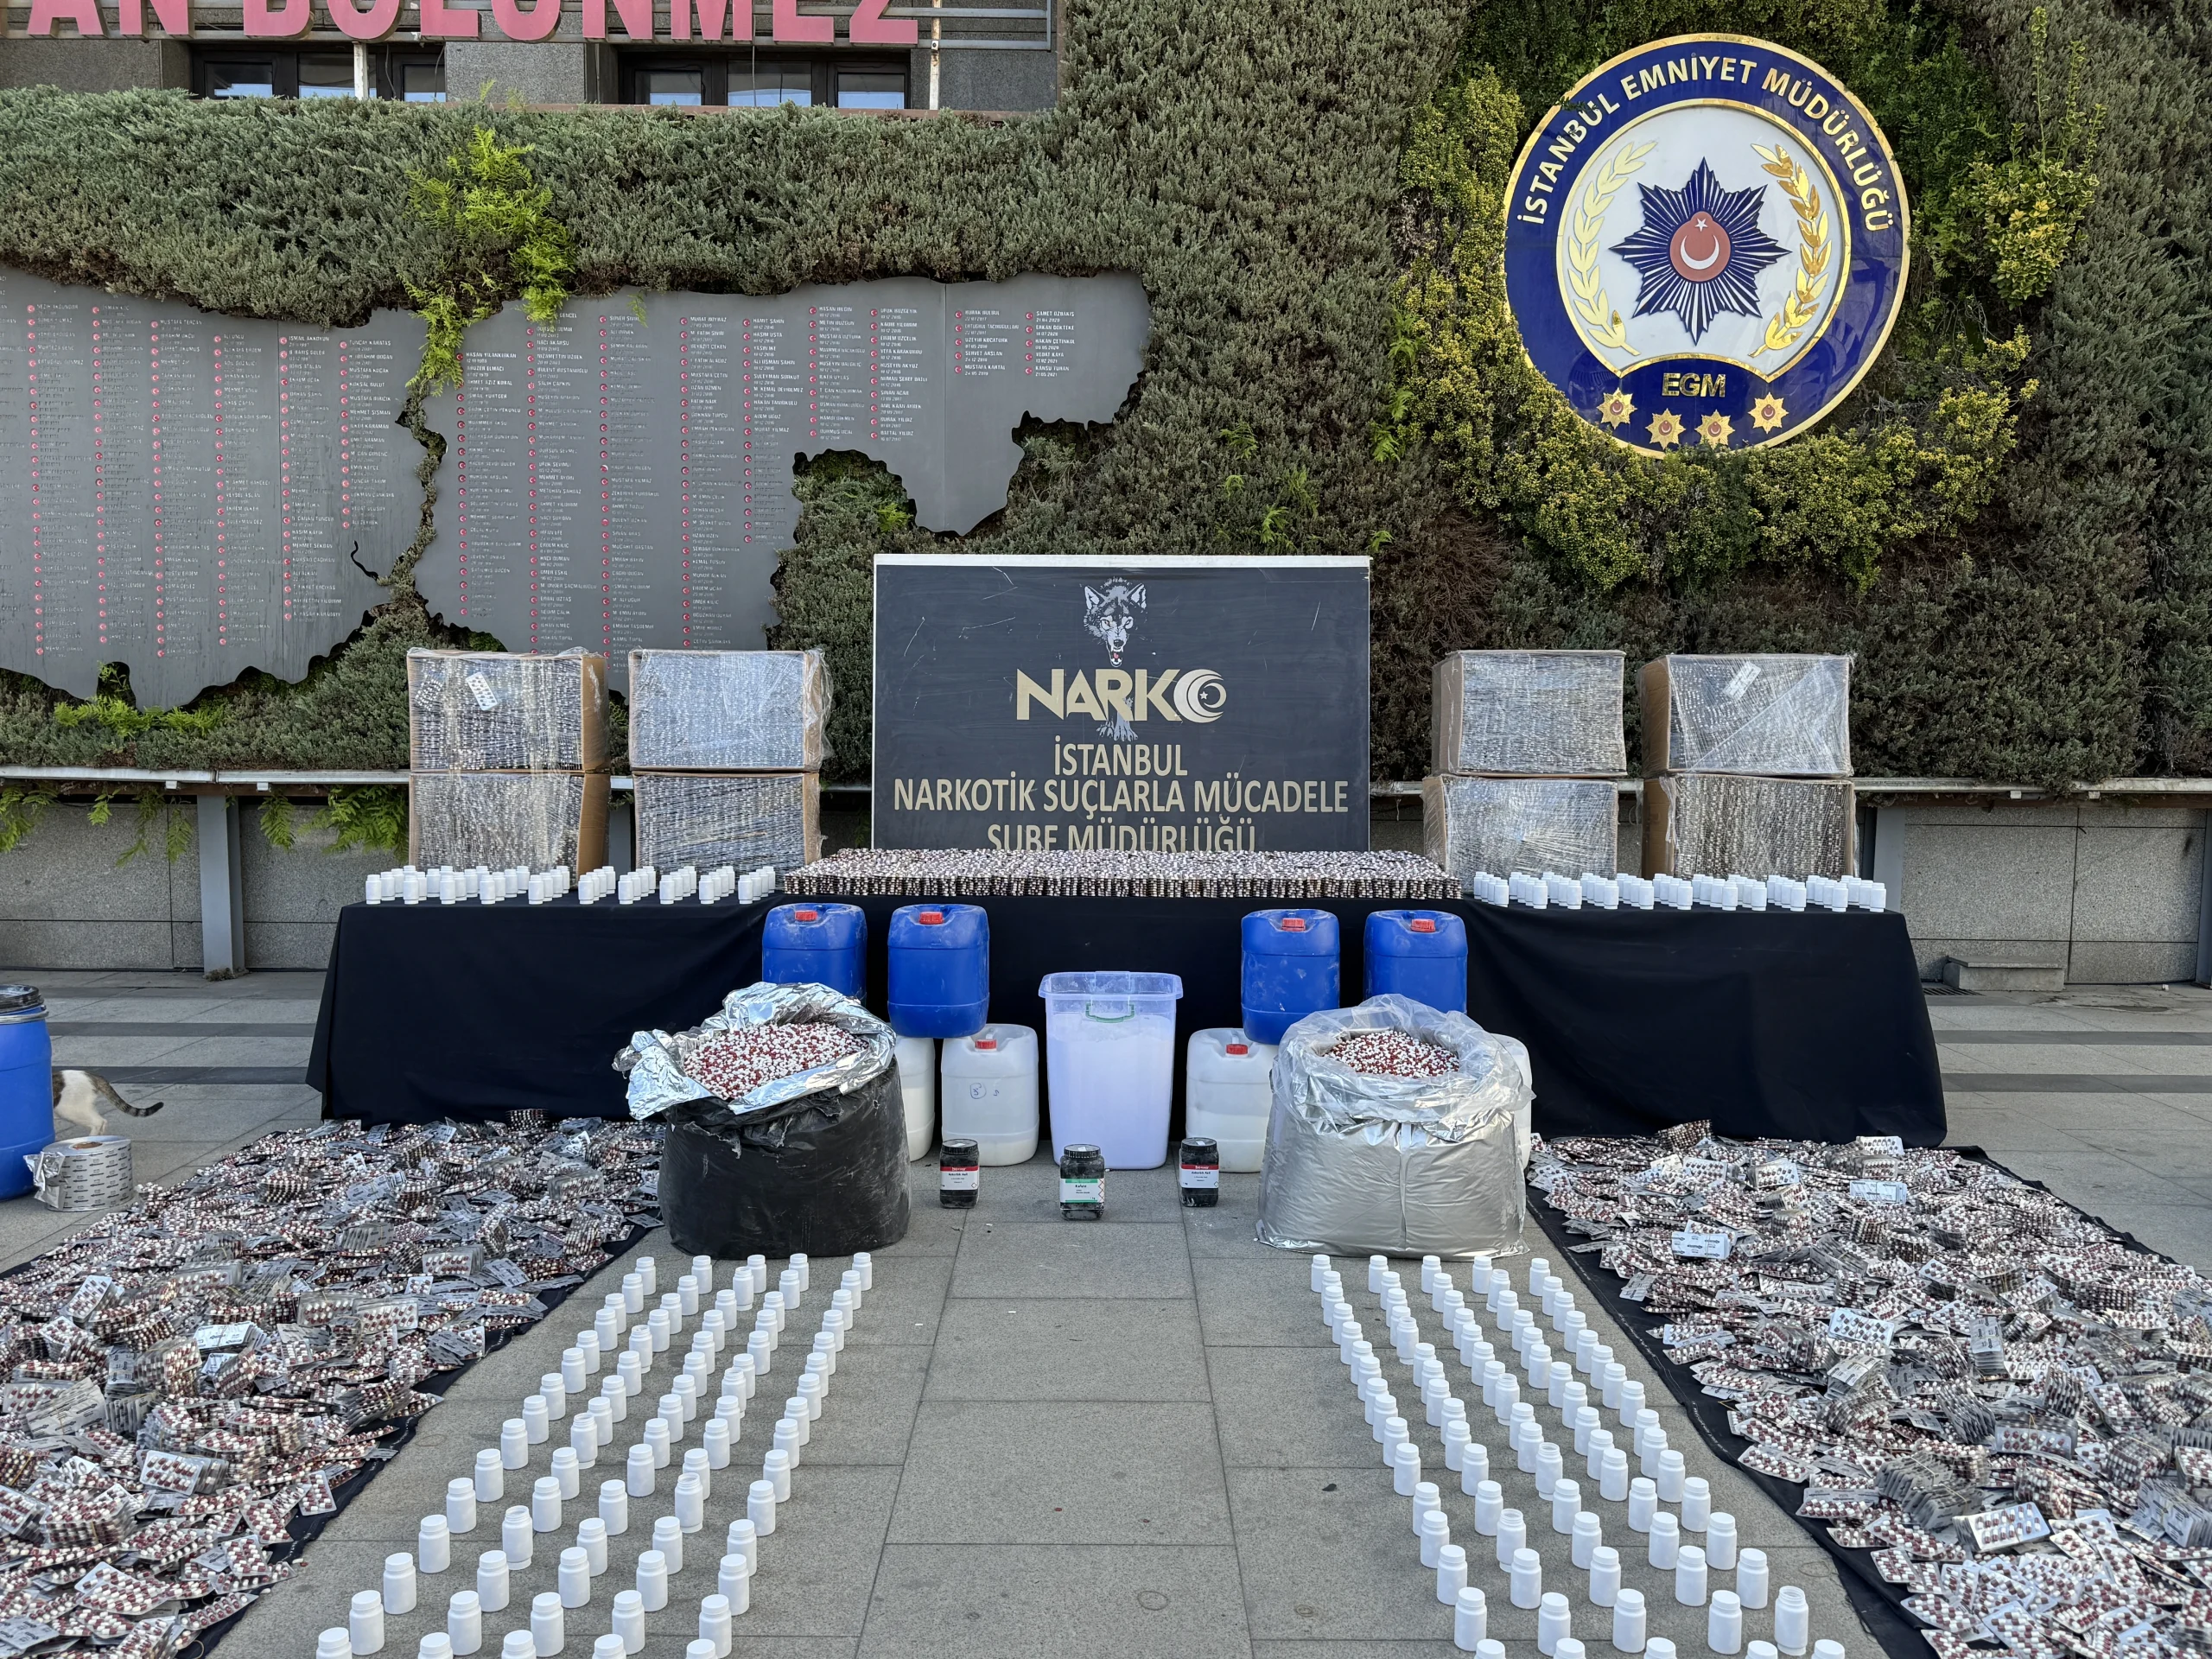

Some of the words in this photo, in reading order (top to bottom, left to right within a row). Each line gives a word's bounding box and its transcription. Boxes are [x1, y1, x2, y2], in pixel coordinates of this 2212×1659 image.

[1620, 53, 1758, 101] EMNİYET
[1761, 67, 1894, 232] MÜDÜRLÜĞÜ
[1661, 372, 1726, 397] EGM
[1016, 668, 1227, 722] NARKO
[1054, 735, 1187, 776] İSTANBUL
[894, 771, 1034, 811] NARKOTİK
[1044, 779, 1185, 819] SUÇLARLA
[1194, 772, 1348, 813] MÜCADELE
